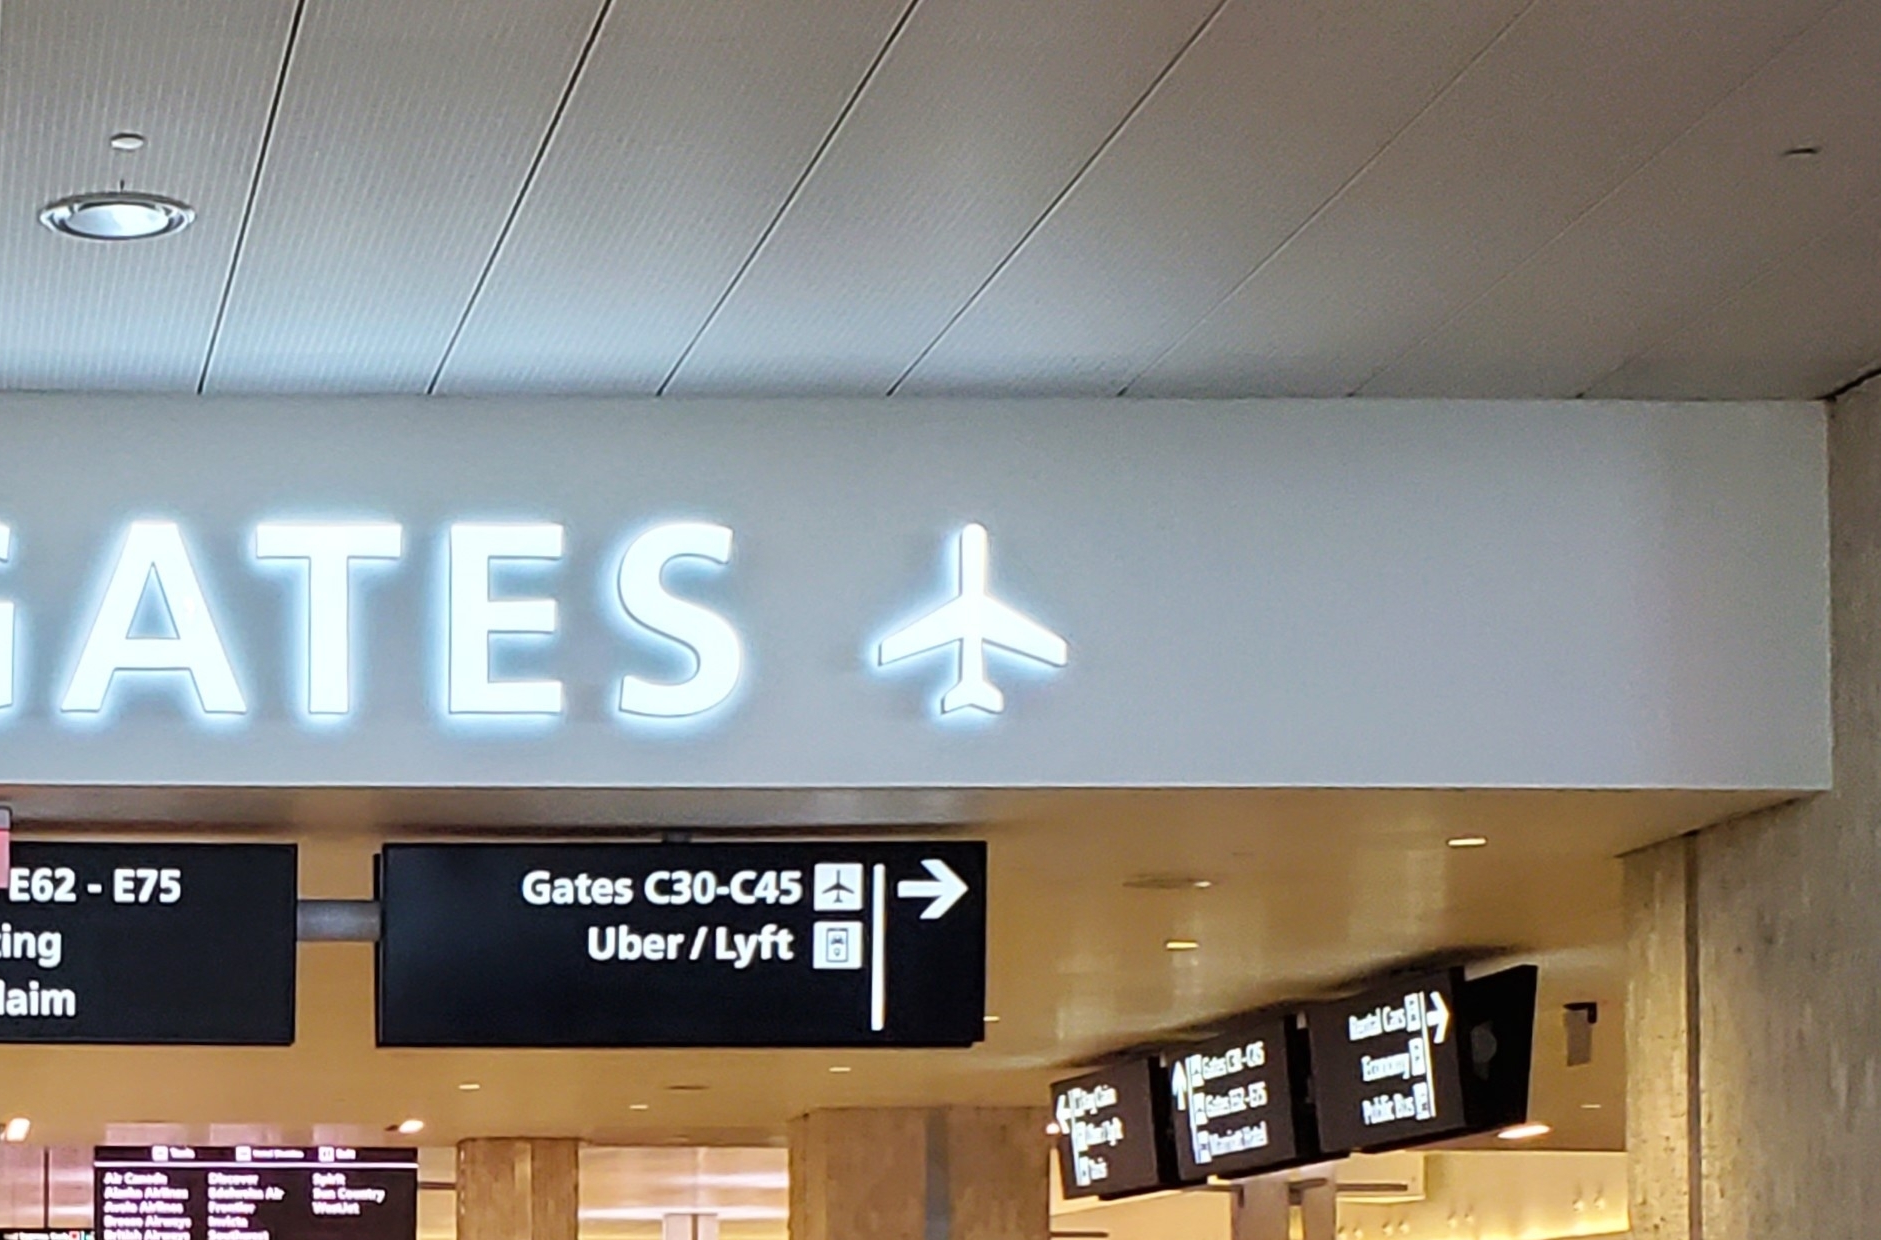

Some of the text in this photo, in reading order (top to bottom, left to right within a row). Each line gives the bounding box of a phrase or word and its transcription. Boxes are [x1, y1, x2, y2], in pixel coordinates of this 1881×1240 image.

[10, 867, 77, 902] E62
[114, 868, 182, 903] E75
[521, 869, 802, 905] Gates C30-C45
[587, 925, 684, 961] Uber
[715, 924, 795, 969] Lyft
